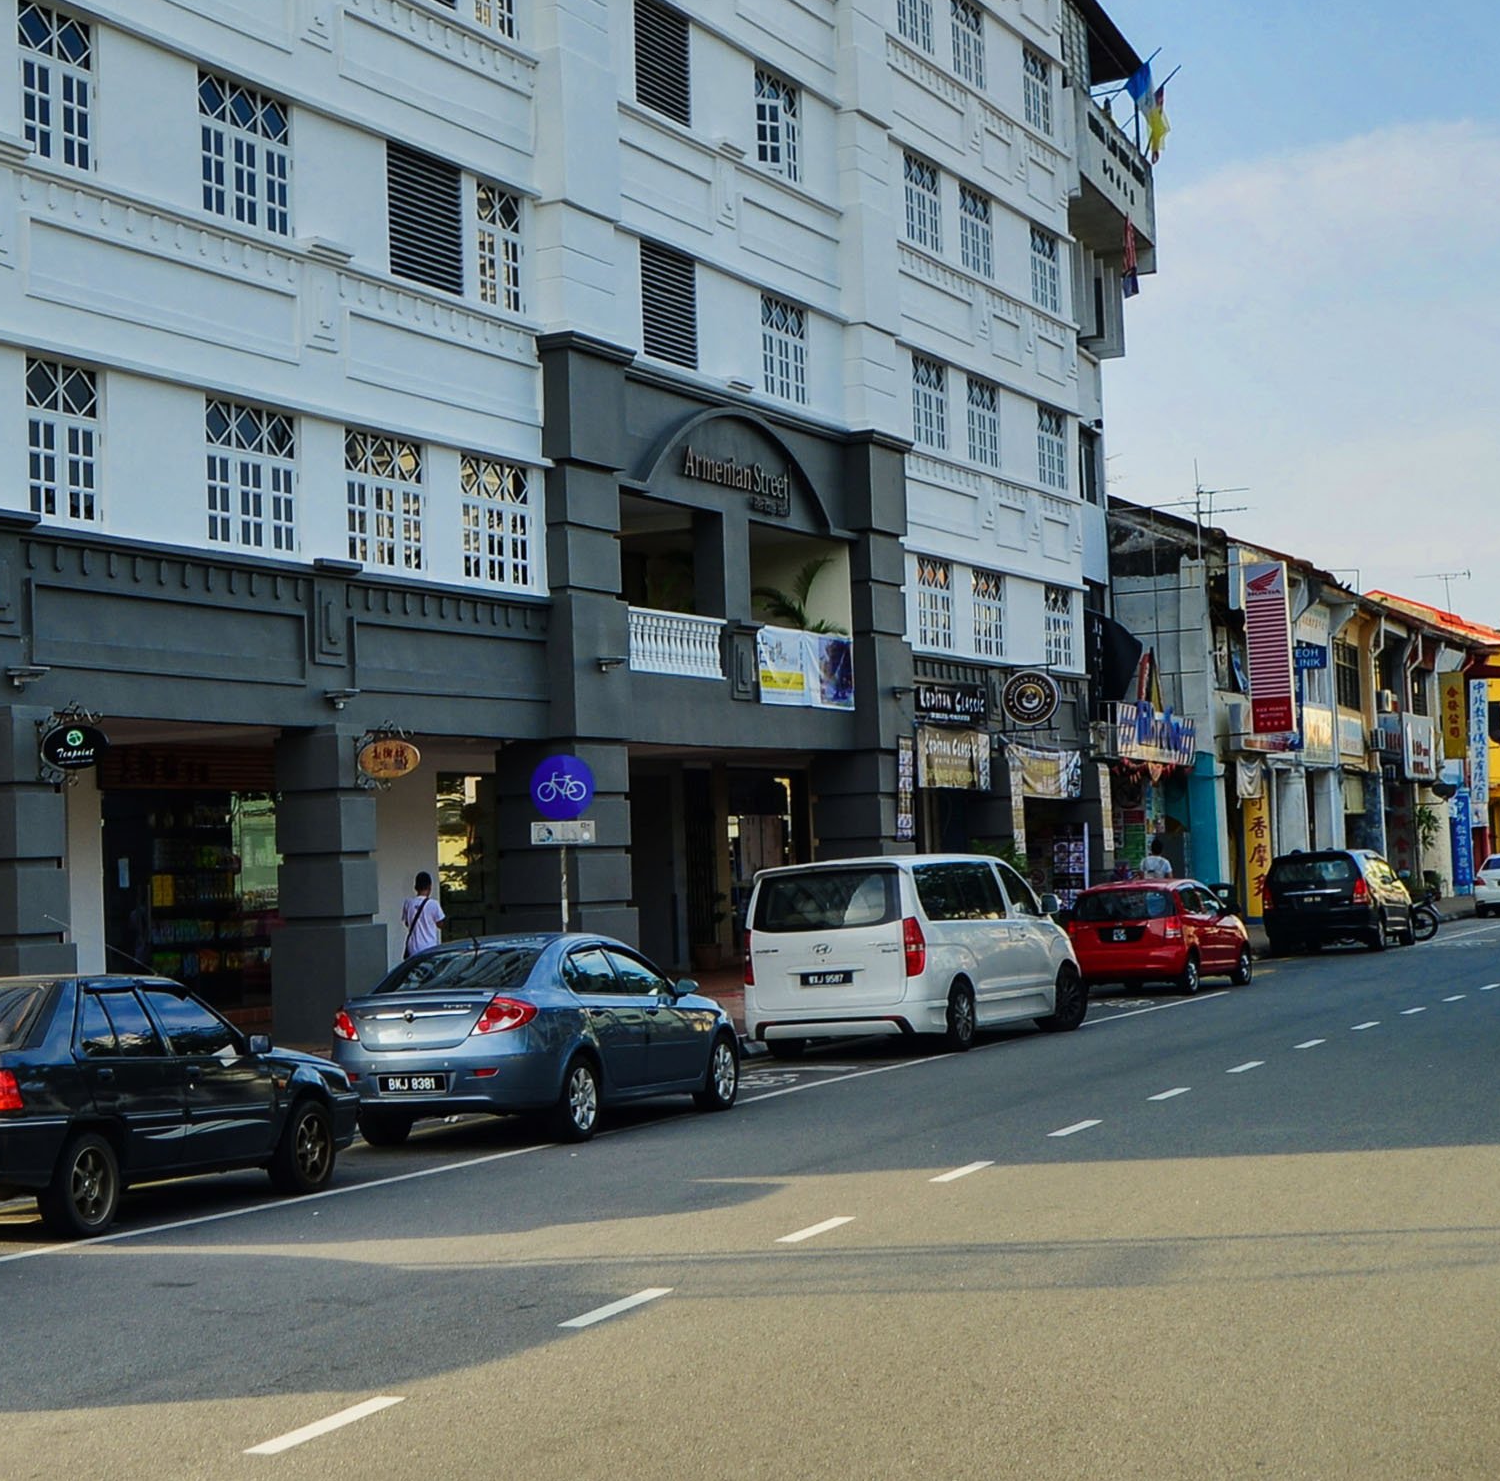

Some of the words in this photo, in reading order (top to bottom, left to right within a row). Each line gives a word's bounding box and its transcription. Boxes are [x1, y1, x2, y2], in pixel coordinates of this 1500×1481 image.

[684, 444, 752, 491] Armenian
[753, 462, 789, 500] Street
[1295, 647, 1318, 659] EOH
[1294, 658, 1321, 669] LINIK
[388, 1078, 409, 1090] BKJ
[411, 1078, 436, 1090] 8381
